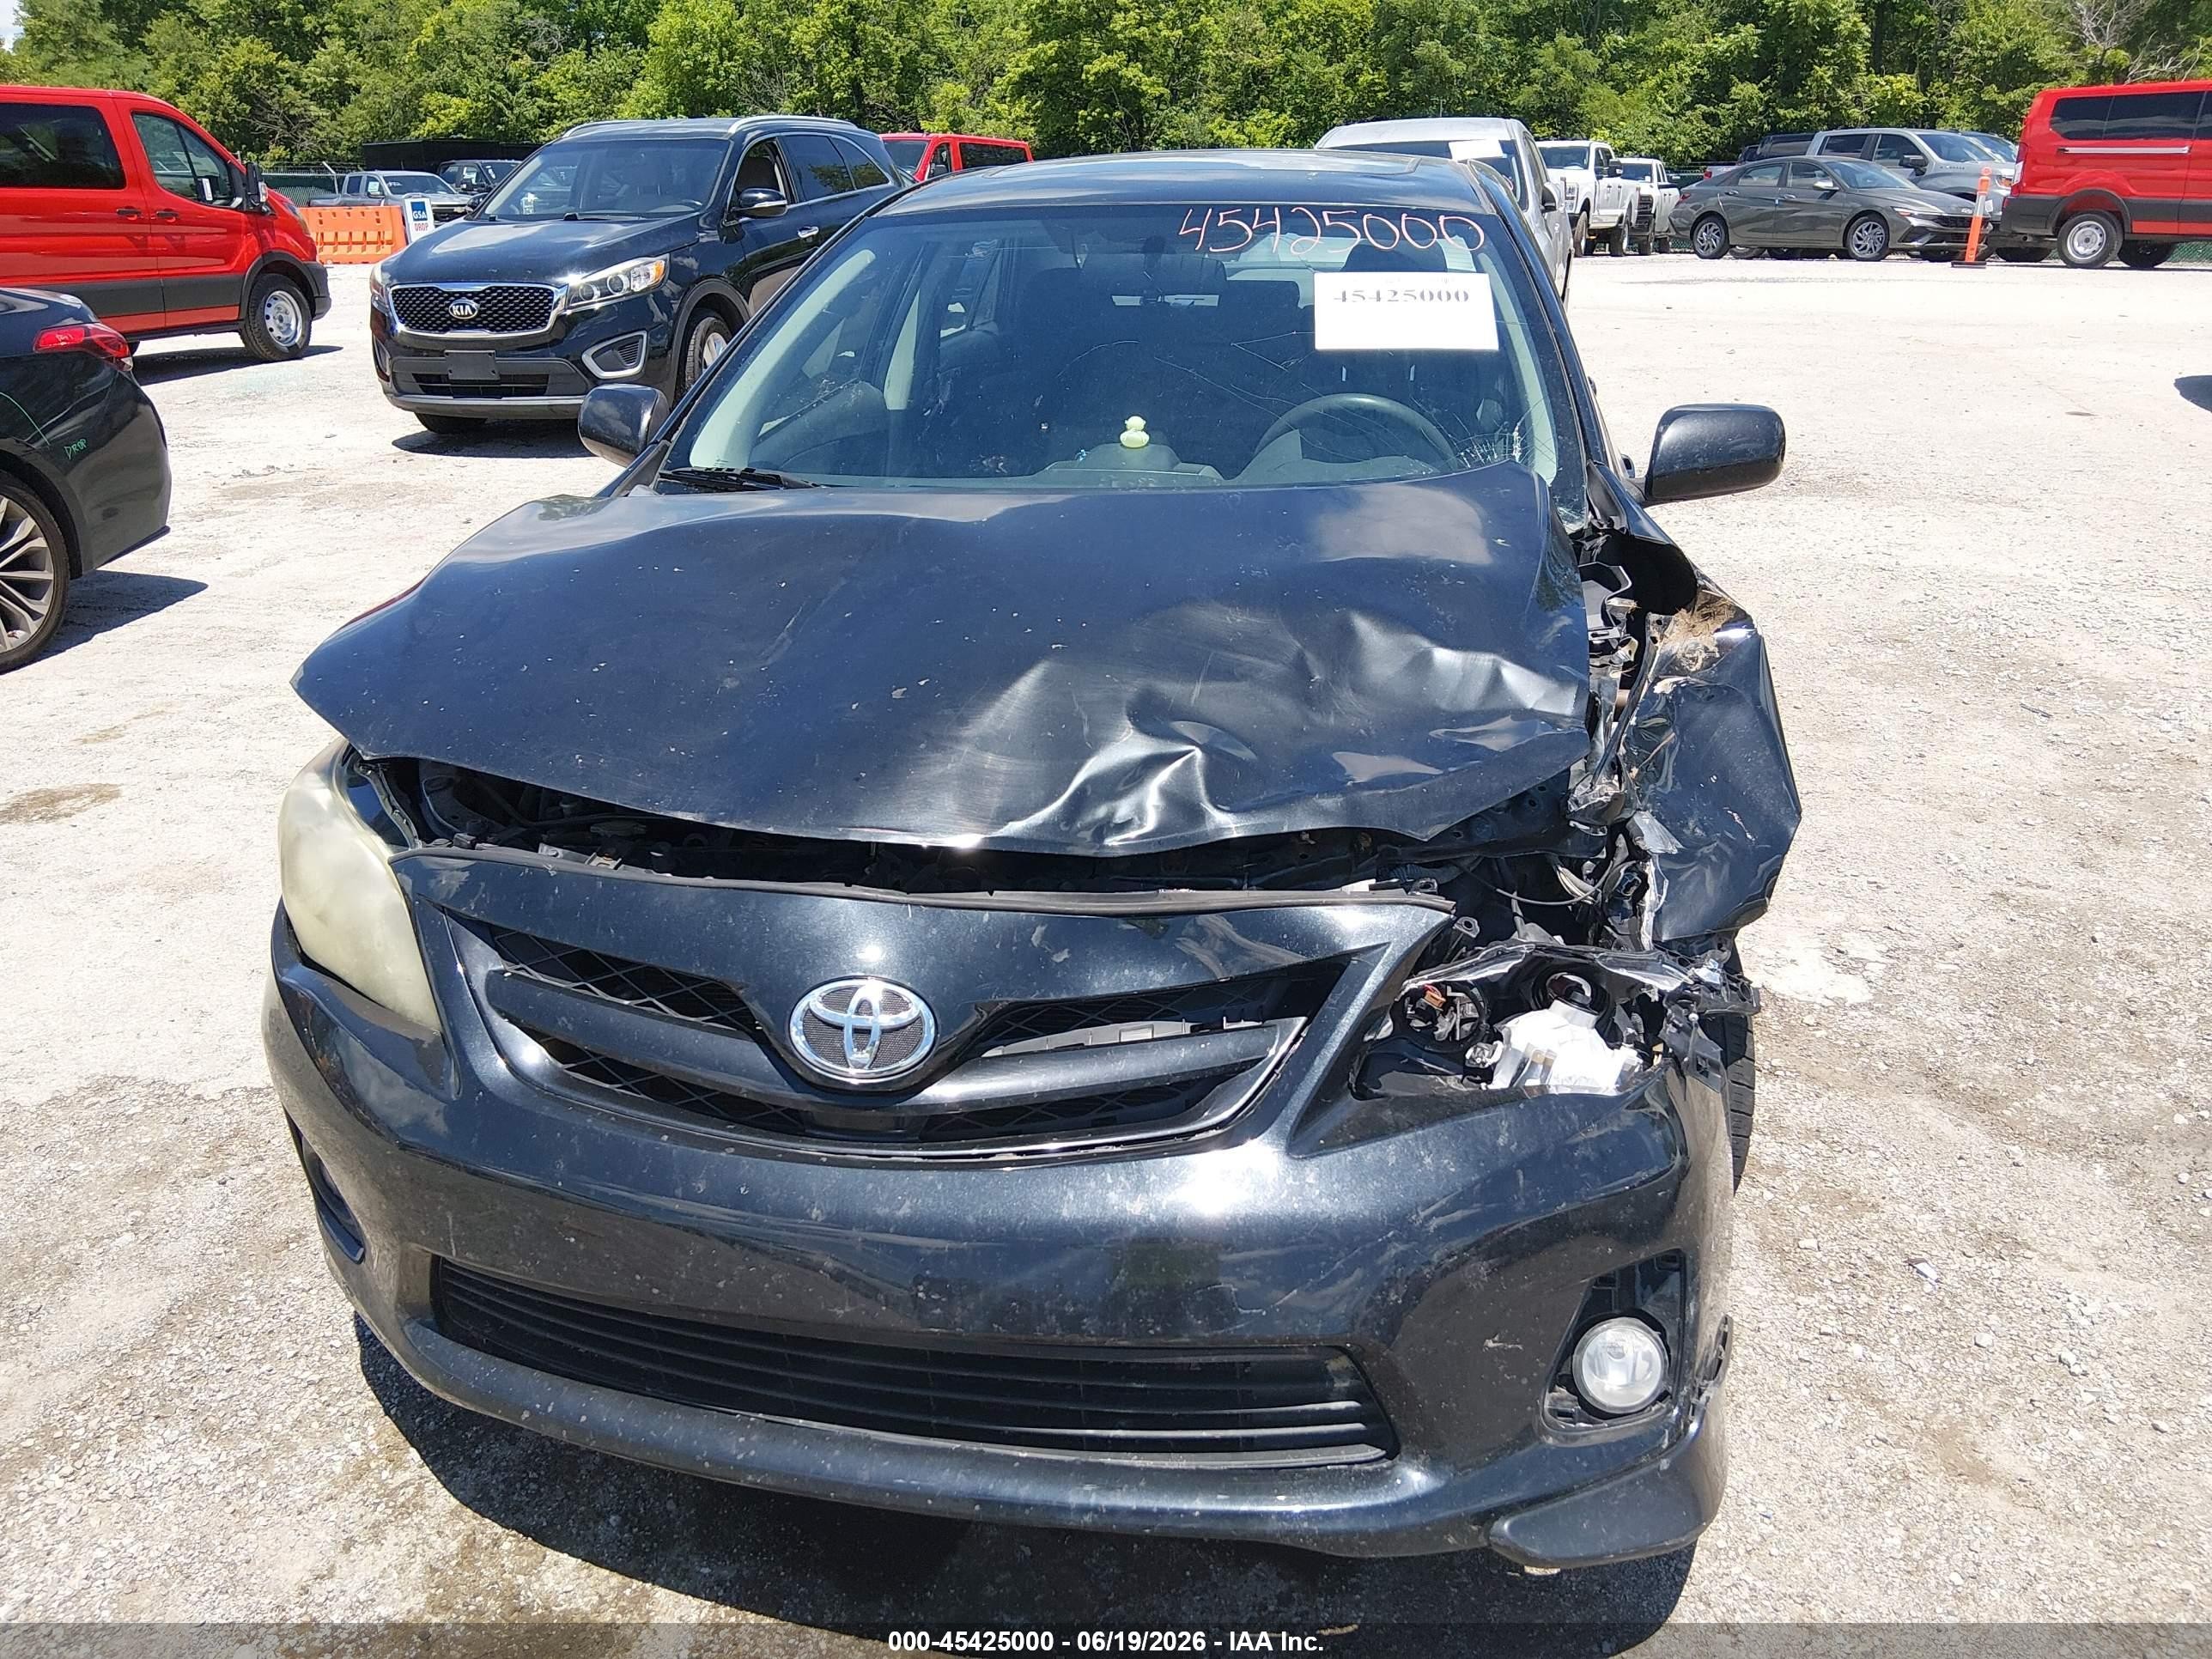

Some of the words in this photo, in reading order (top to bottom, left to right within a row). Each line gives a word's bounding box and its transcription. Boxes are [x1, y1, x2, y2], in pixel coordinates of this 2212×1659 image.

[413, 210, 427, 219] GSA
[1178, 206, 1485, 255] 45425000
[1333, 289, 1469, 302] 45425000
[453, 305, 473, 315] KIA
[64, 439, 87, 460] DROP
